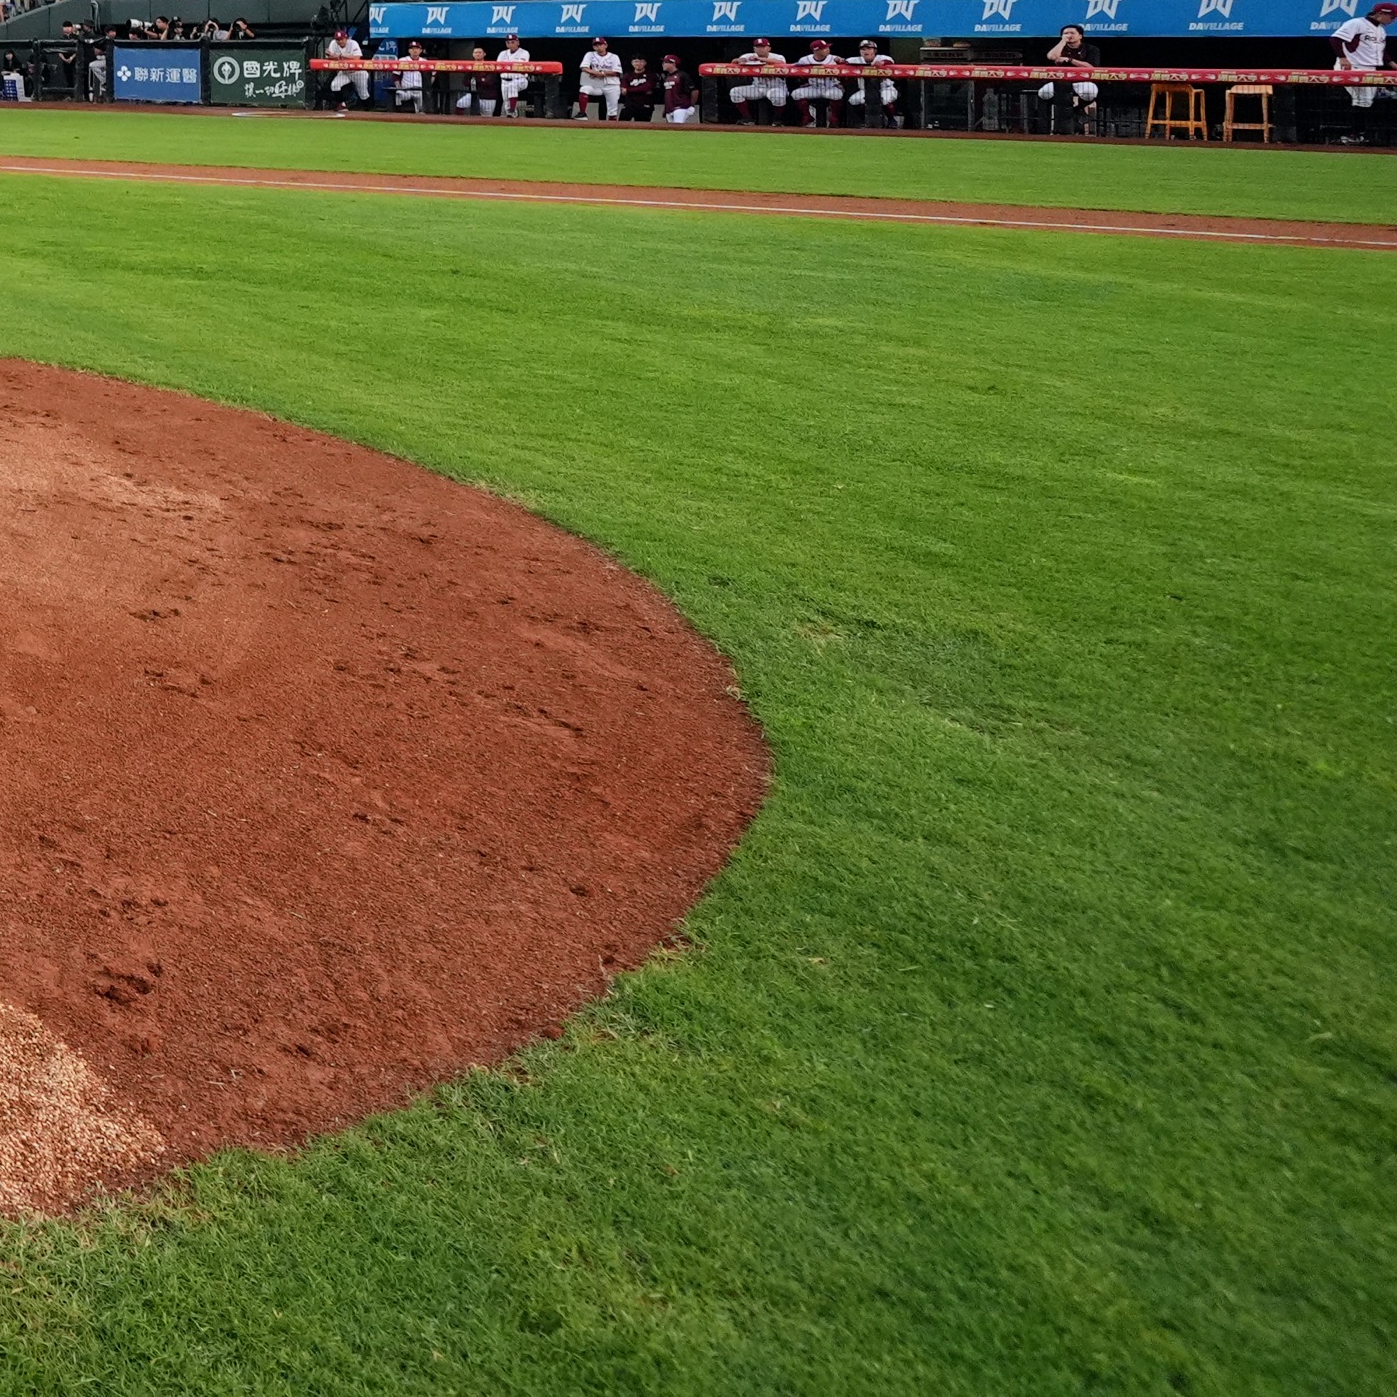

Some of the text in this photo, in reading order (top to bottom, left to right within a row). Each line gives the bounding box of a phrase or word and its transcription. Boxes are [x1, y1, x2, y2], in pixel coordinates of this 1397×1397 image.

[706, 24, 744, 32] DAVILLAGE
[790, 24, 831, 32] DAVILLAGE
[879, 24, 923, 32] DAVILLAGE
[974, 24, 1022, 32] DAVILLAGE
[1189, 22, 1244, 30] DAVILLAGE
[134, 66, 197, 83] 聯新運醫
[243, 60, 303, 82] 國光牌
